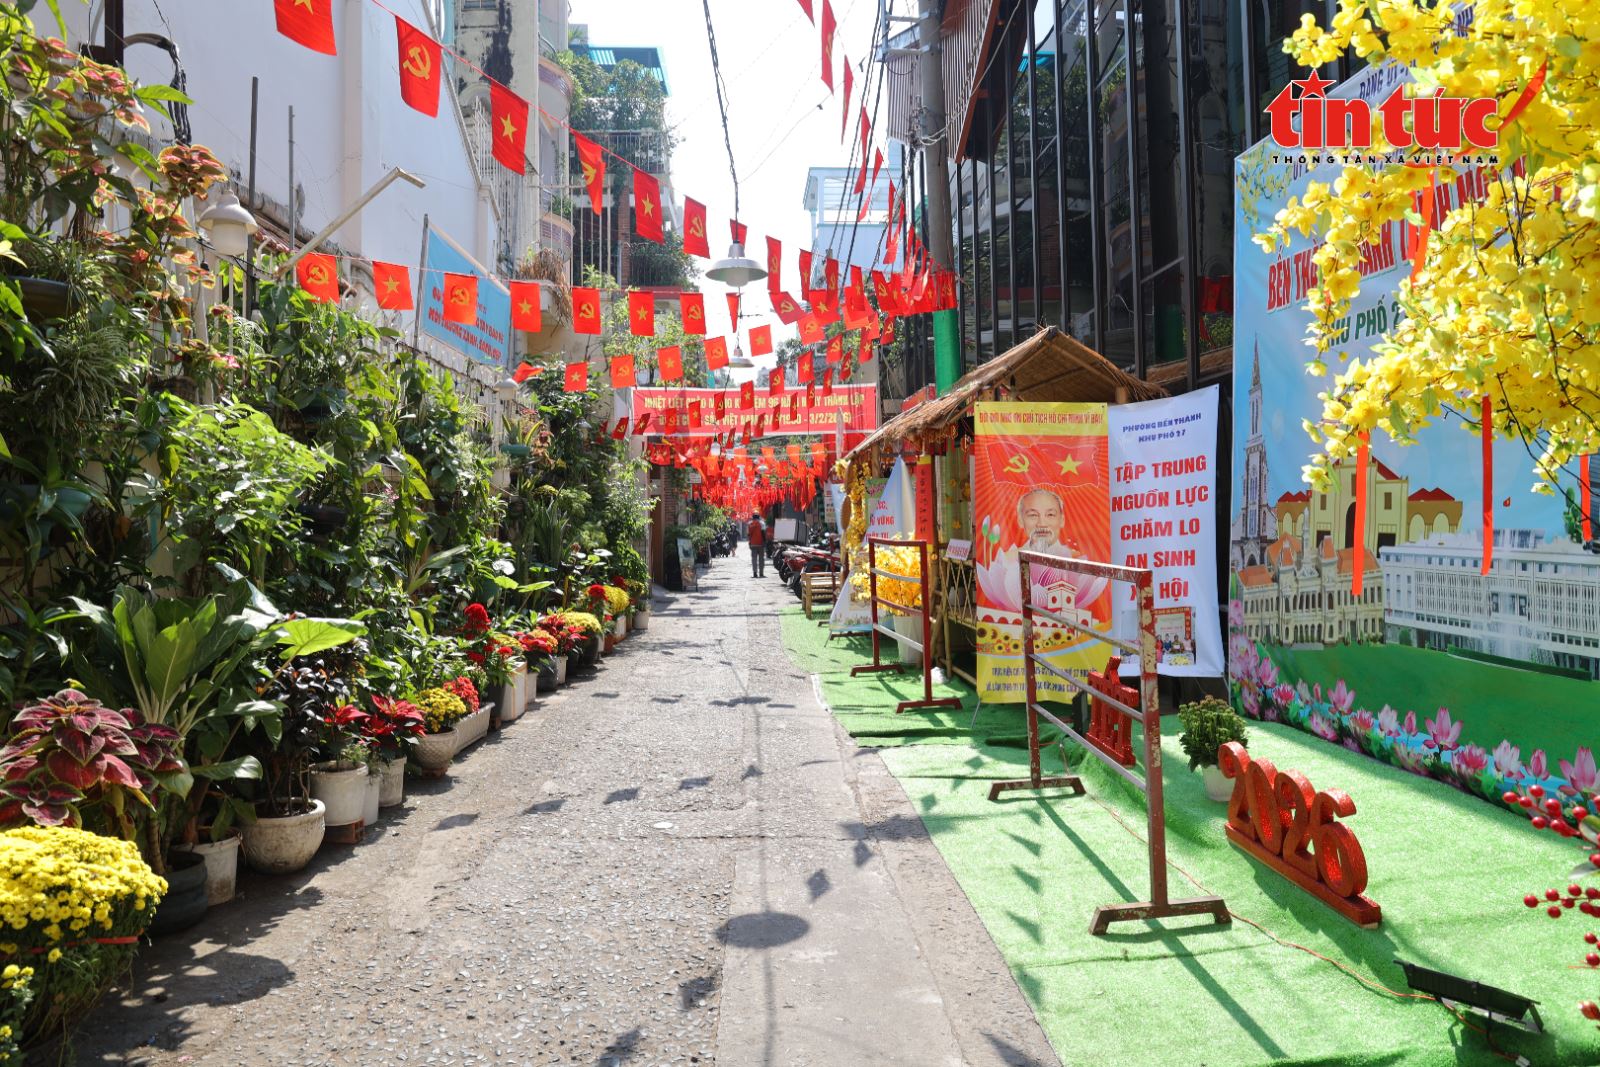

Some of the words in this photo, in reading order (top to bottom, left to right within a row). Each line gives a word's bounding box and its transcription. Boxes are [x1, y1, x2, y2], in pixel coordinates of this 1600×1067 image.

[1267, 244, 1291, 311] BẾN
[1354, 293, 1388, 340] PHỐ
[1114, 461, 1147, 484] TẬP
[1151, 454, 1207, 479] TRUNG
[1111, 488, 1170, 513] NGUỒN
[1175, 485, 1209, 508] LỰC
[1120, 518, 1172, 541] CHĂM
[1179, 518, 1201, 536] LO
[1125, 552, 1148, 569] AN
[1153, 549, 1196, 568] SINH
[1159, 577, 1189, 602] HỘI
[1217, 740, 1370, 898] 2026
